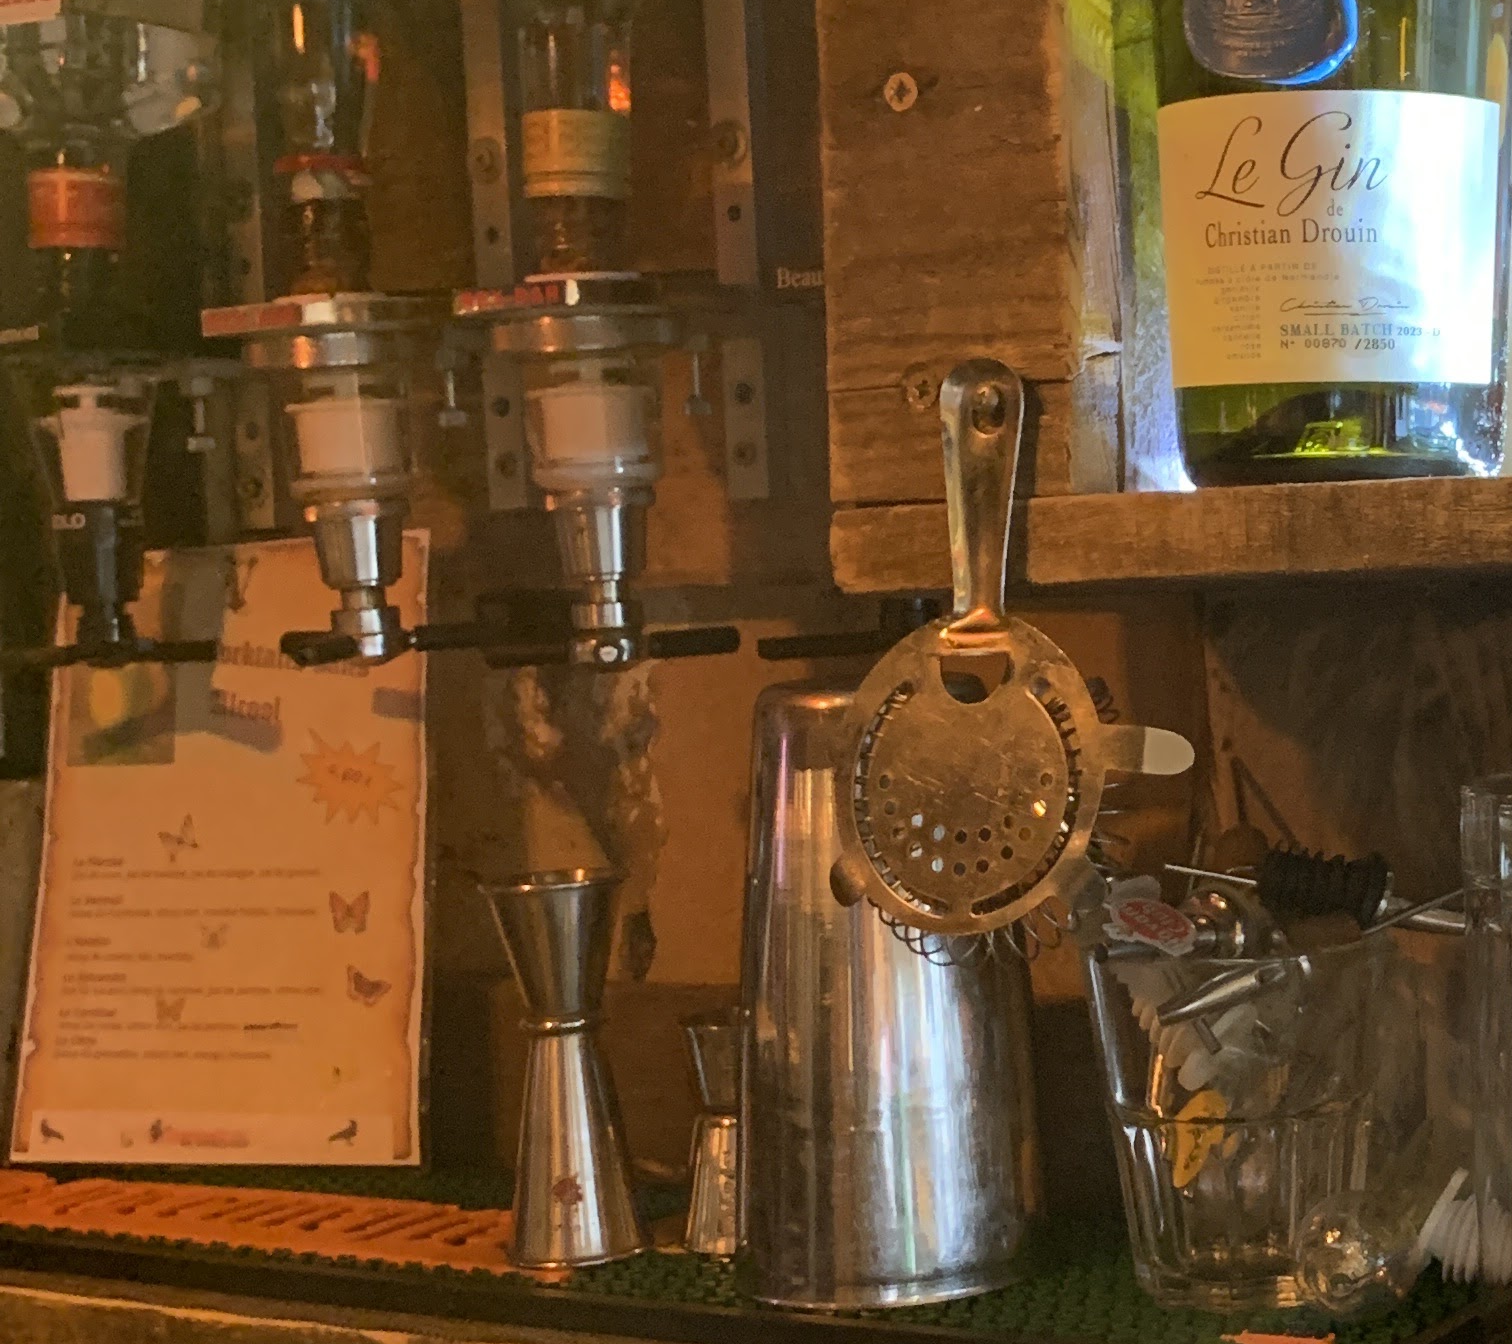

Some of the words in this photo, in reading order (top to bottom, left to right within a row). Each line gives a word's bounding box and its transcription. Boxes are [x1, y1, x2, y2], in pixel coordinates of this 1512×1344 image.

[1195, 115, 1266, 209] Le
[1276, 110, 1390, 217] Gin
[1326, 199, 1345, 217] de
[1204, 219, 1292, 250] Christian
[1301, 217, 1379, 245] Drouin
[1279, 323, 1336, 338] SMALL
[1340, 322, 1394, 337] BATCH
[1396, 326, 1423, 337] 2023
